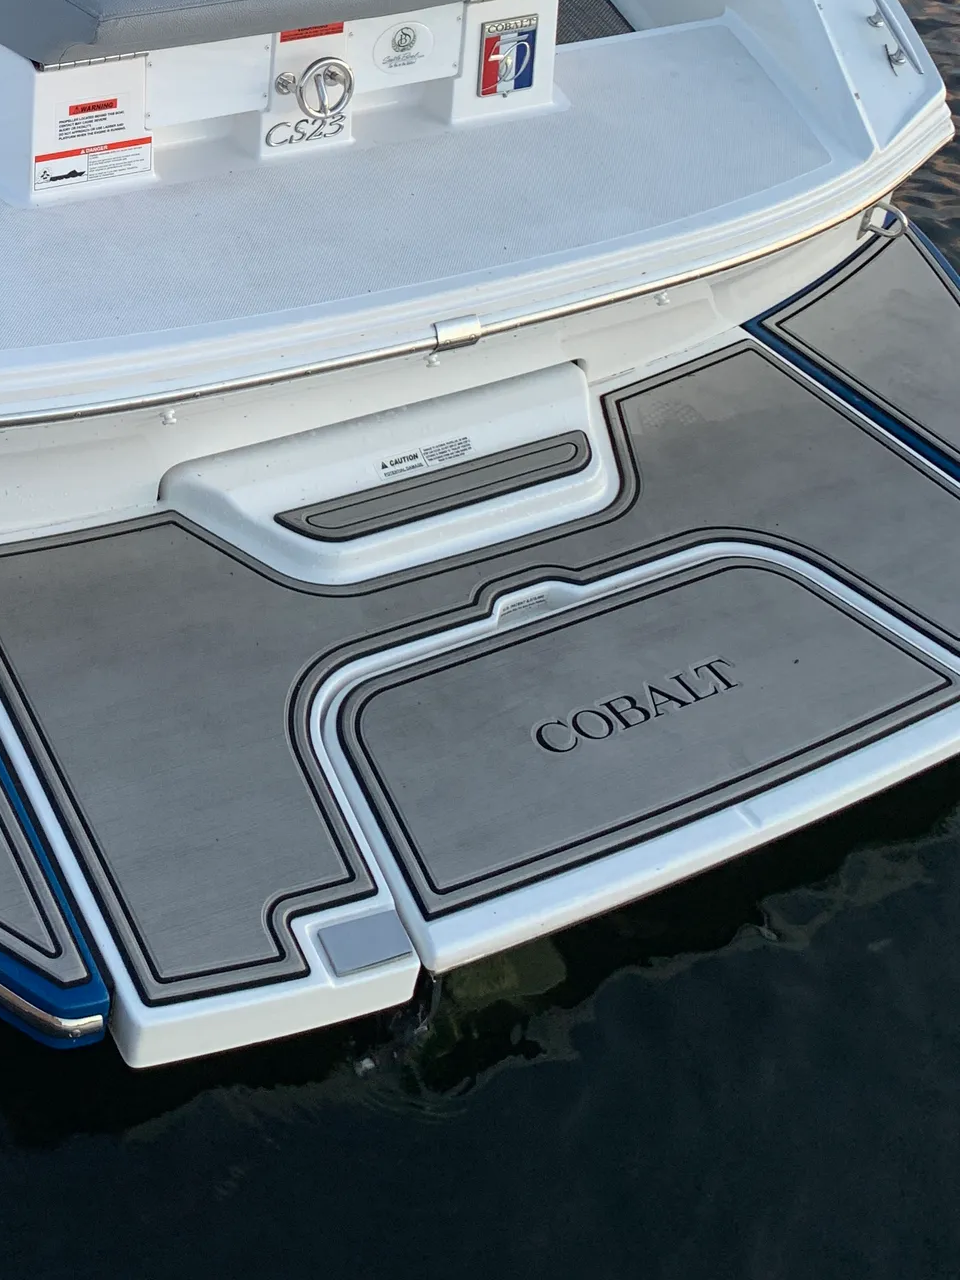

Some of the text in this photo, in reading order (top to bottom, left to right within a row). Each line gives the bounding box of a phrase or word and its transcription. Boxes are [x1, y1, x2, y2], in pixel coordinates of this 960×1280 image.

[487, 17, 537, 34] COBALT
[80, 102, 114, 113] WARNING
[265, 113, 347, 148] CS23
[85, 144, 108, 153] DANGER
[389, 452, 419, 467] CAUTION
[536, 659, 738, 753] COBALT
